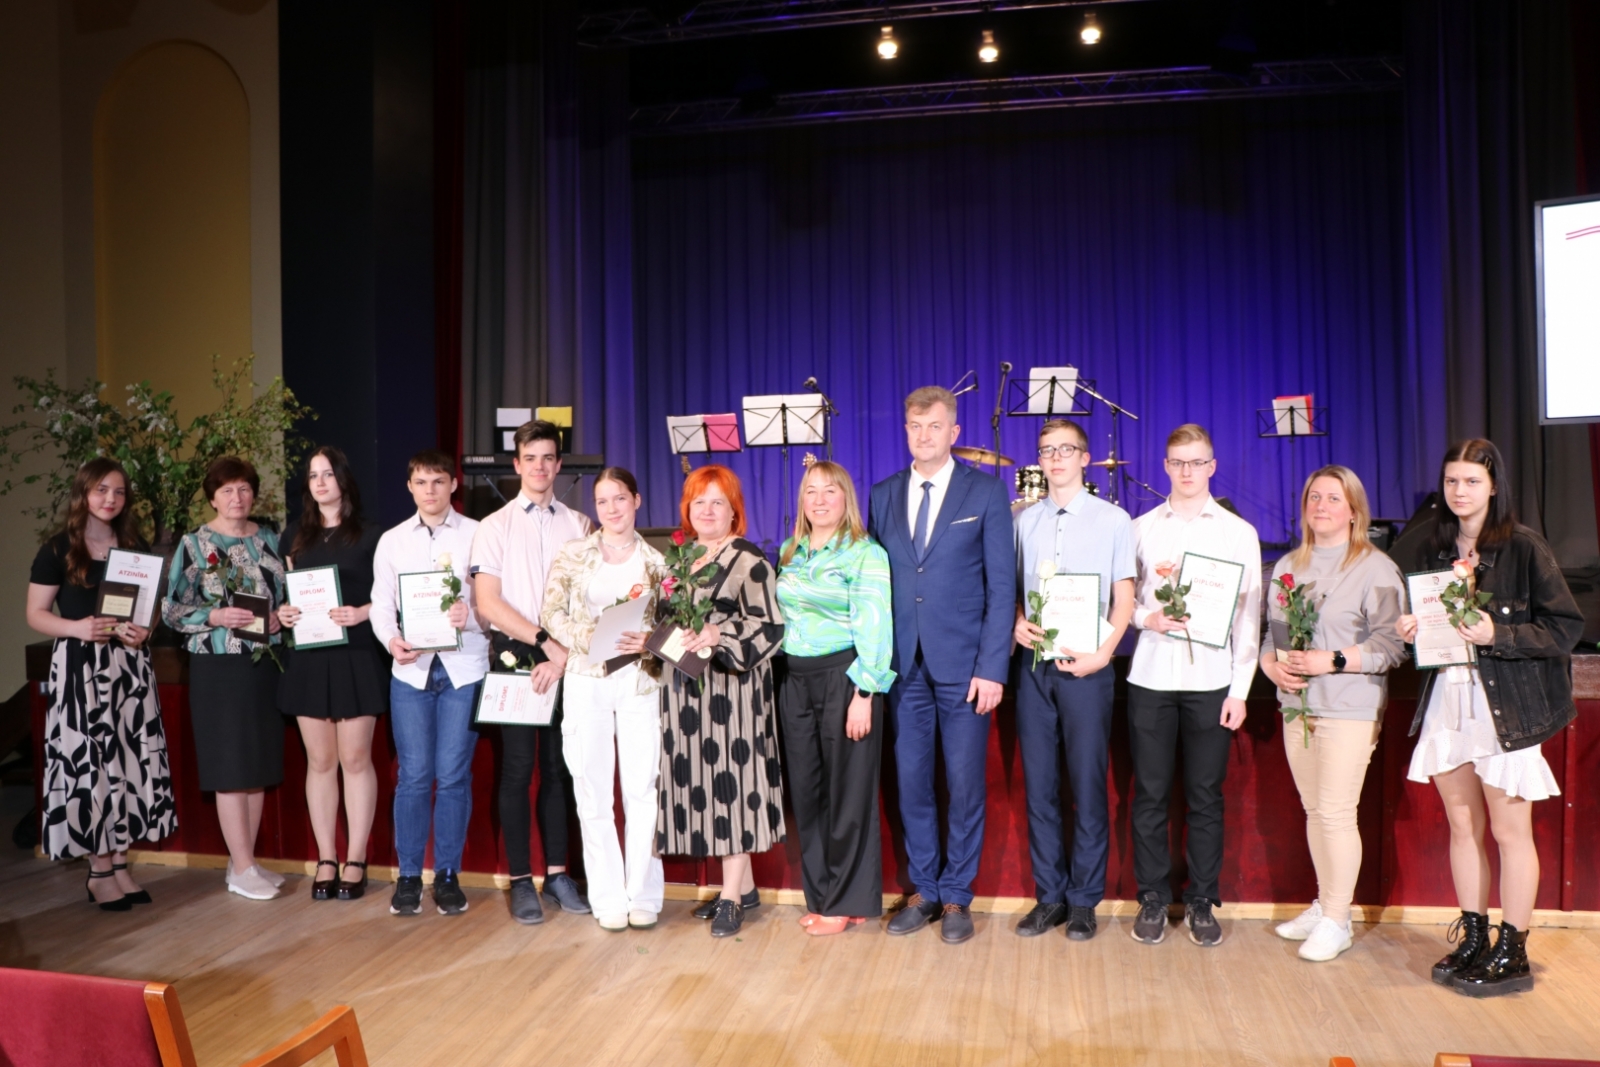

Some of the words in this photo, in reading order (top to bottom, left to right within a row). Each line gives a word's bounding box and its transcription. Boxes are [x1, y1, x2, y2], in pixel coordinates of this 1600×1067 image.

[118, 569, 149, 579] ATZINĪBA
[1193, 577, 1225, 590] DIPLOMS
[299, 587, 326, 596] DIPLOMS
[498, 685, 509, 712] DIPLOMS
